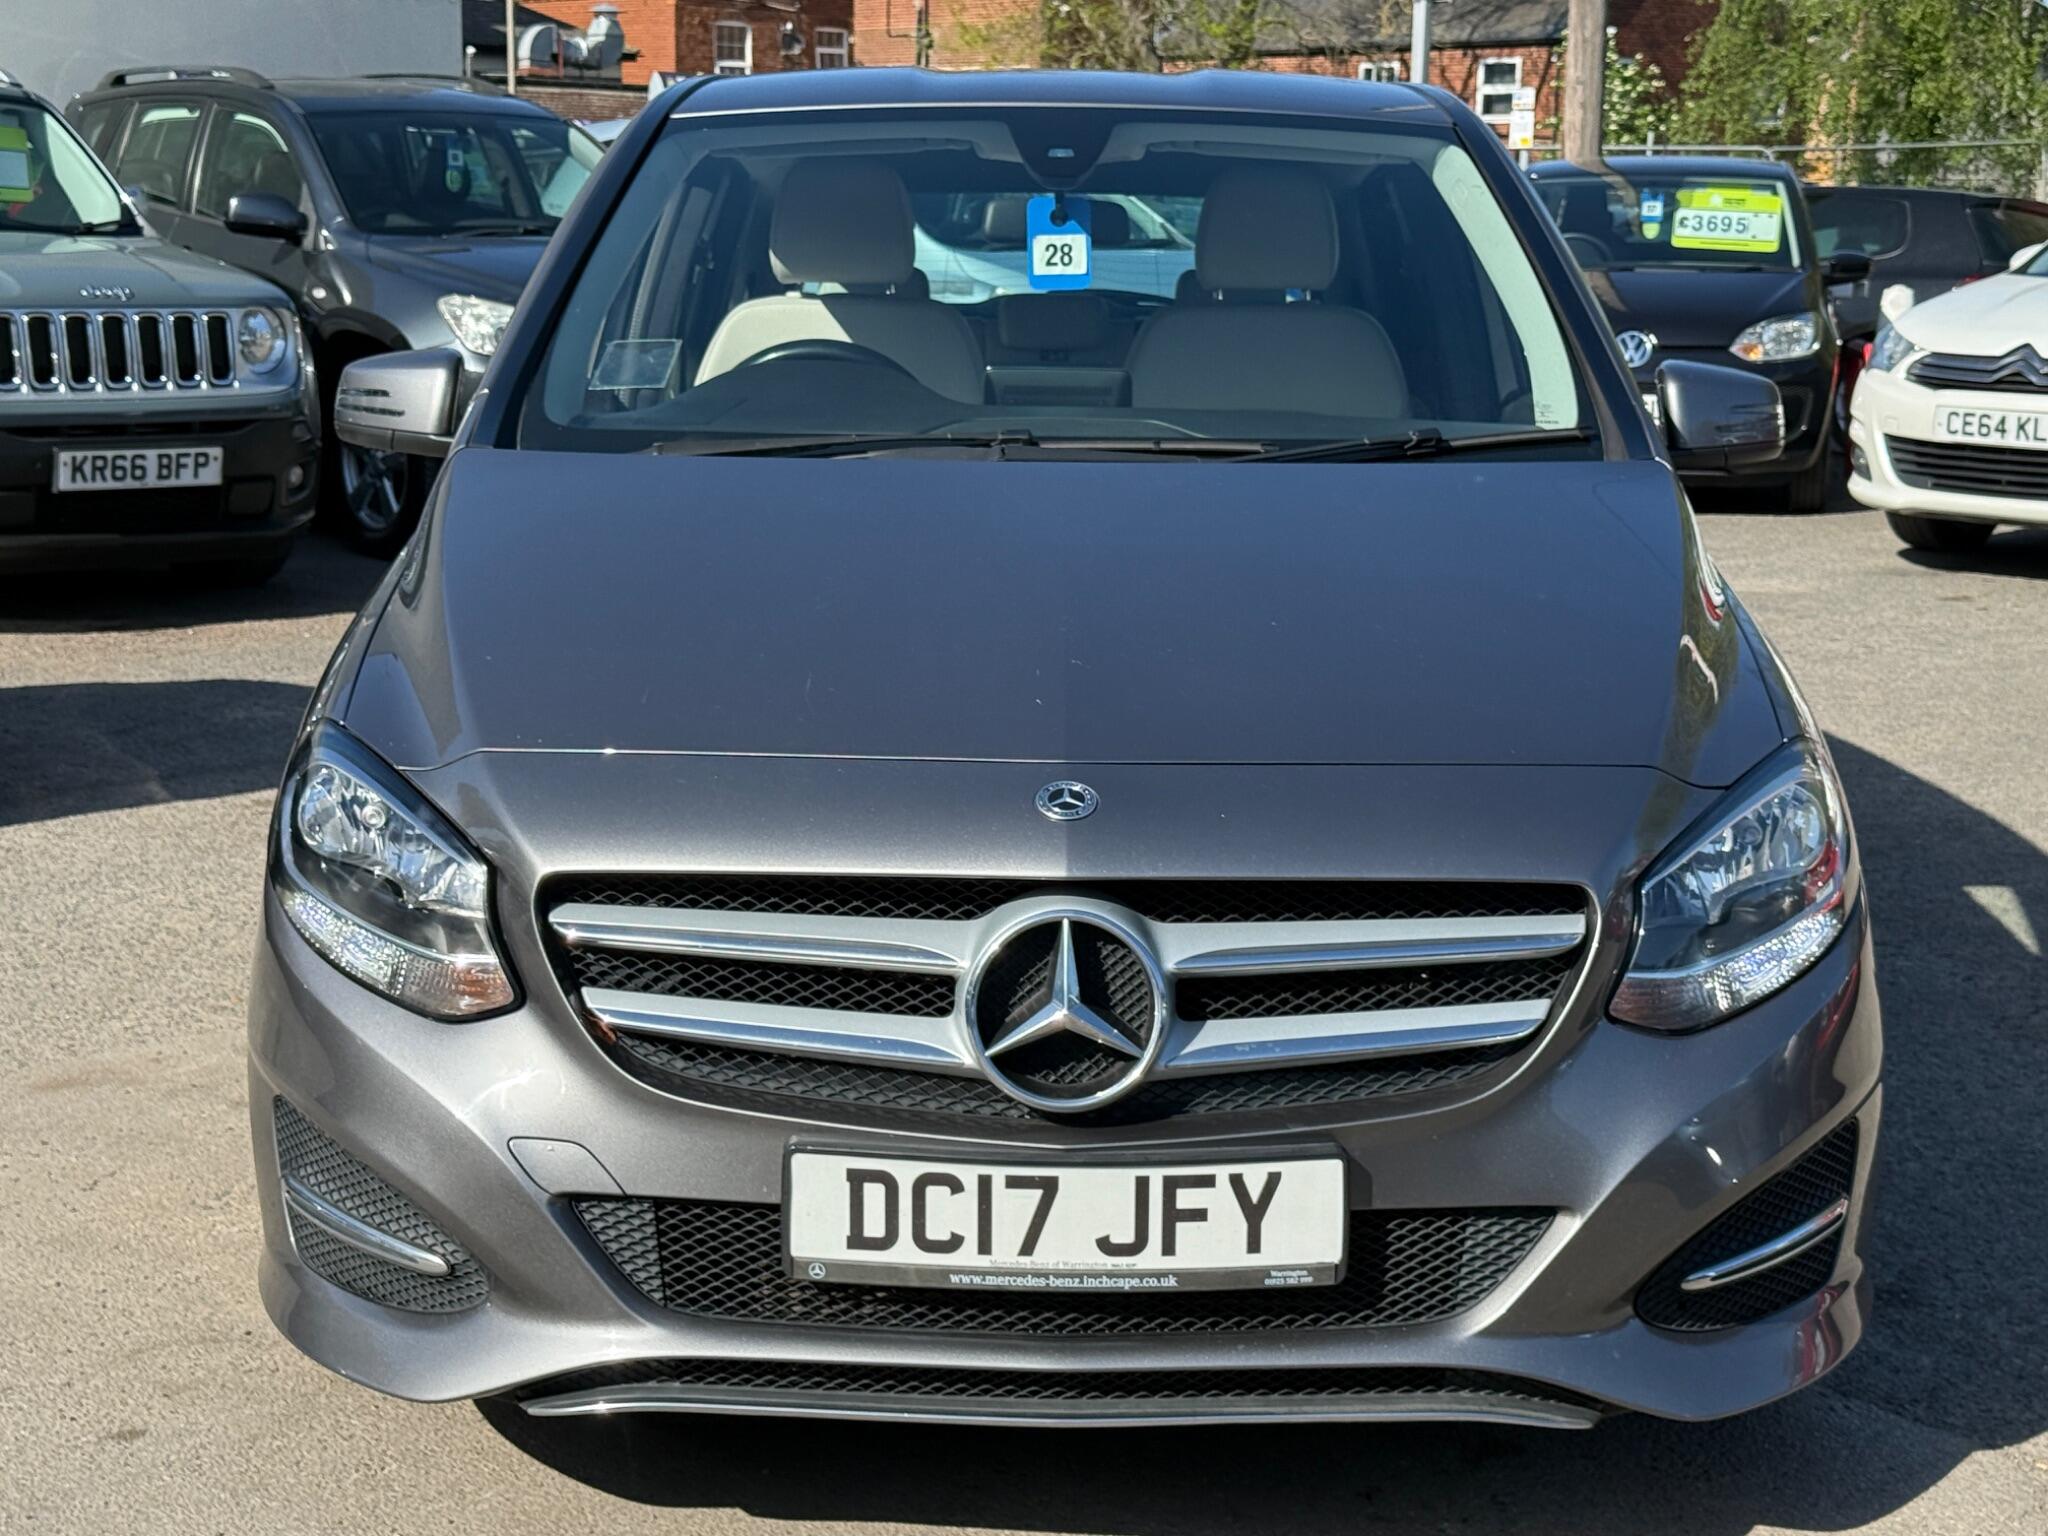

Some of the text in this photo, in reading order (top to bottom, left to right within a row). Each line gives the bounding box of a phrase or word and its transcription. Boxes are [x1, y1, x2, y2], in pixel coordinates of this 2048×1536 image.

[1045, 243, 1073, 267] 28
[1946, 411, 2007, 439] CE64
[70, 451, 211, 484] KR66 BFP
[846, 1167, 1282, 1257] DC17 JFY
[949, 1272, 1178, 1289] www.mercedes-benz.inchcape.co.uk
